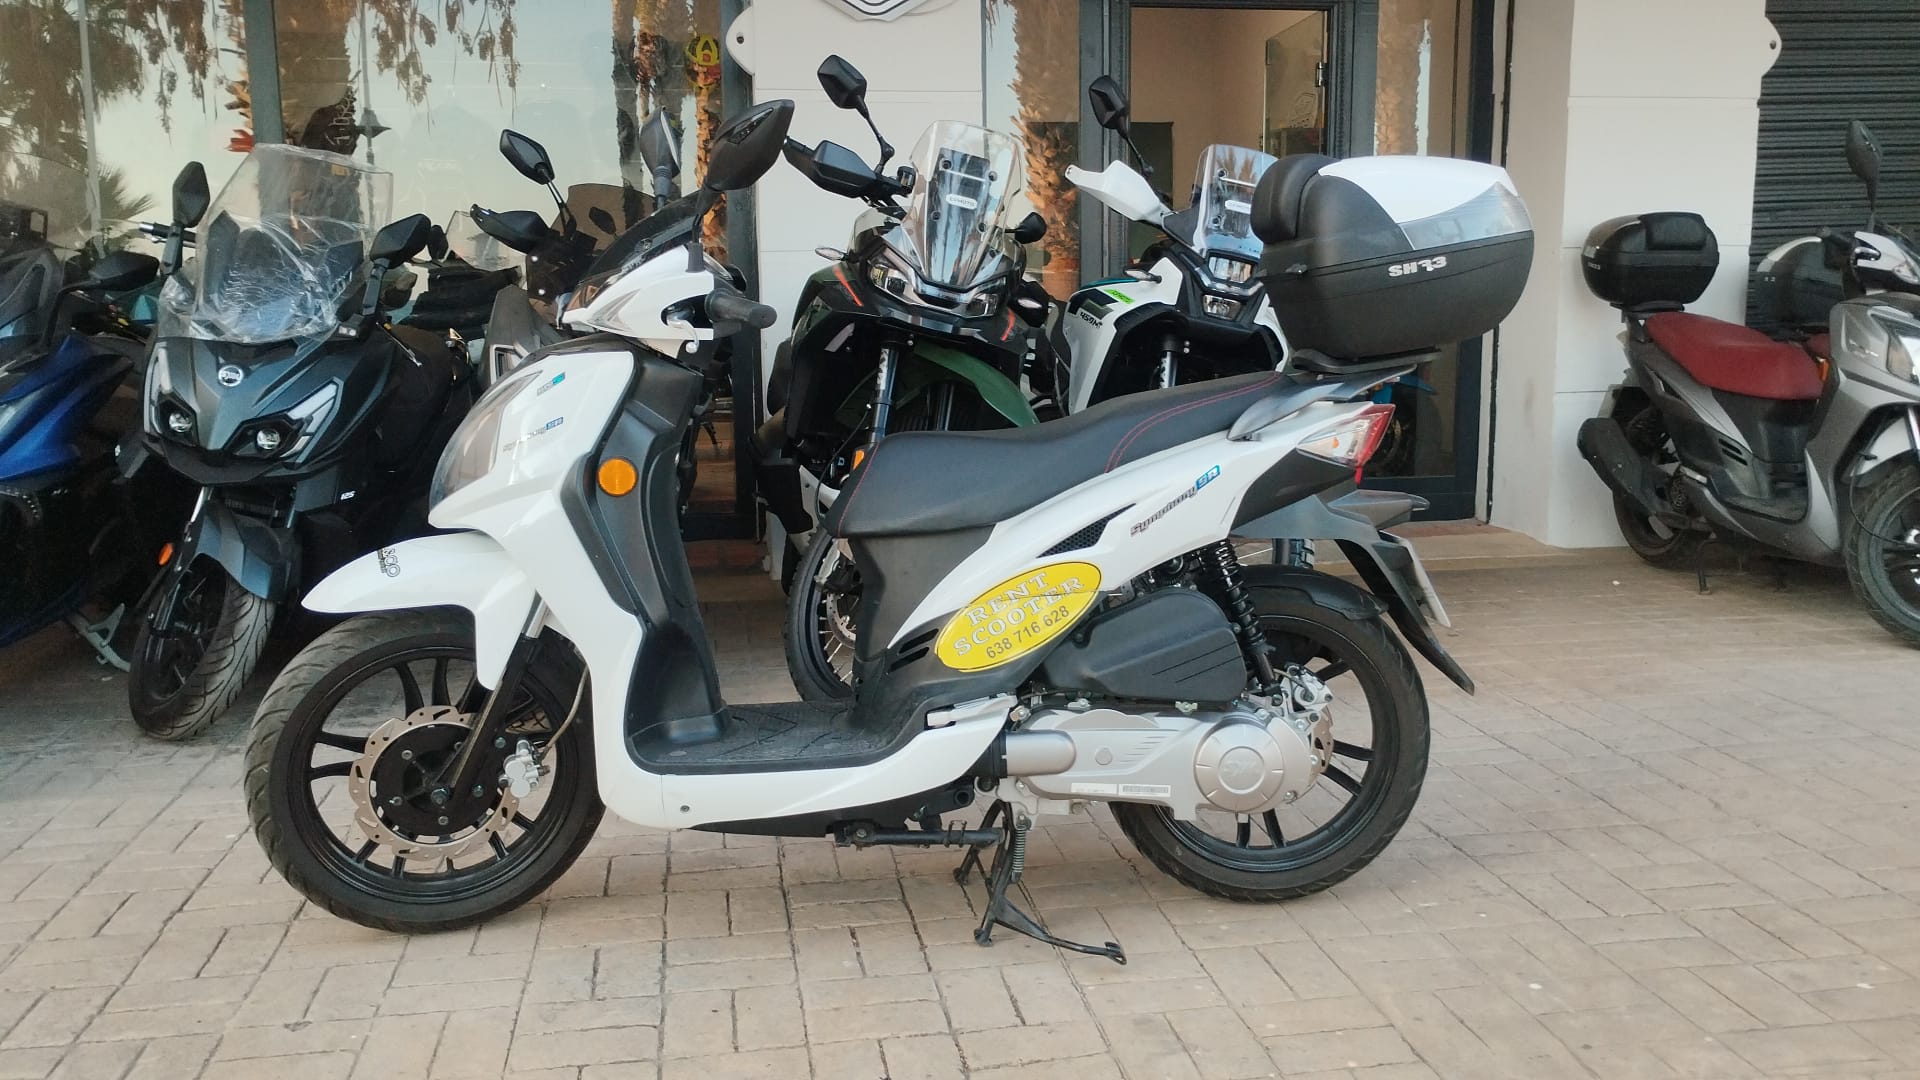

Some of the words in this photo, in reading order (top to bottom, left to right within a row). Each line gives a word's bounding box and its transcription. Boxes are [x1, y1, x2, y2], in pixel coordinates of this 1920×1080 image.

[953, 577, 1084, 656] SCOOTER
[966, 572, 1049, 627] RENT
[986, 637, 1013, 659] 638
[1013, 621, 1042, 643] 716
[1042, 605, 1070, 627] 628
